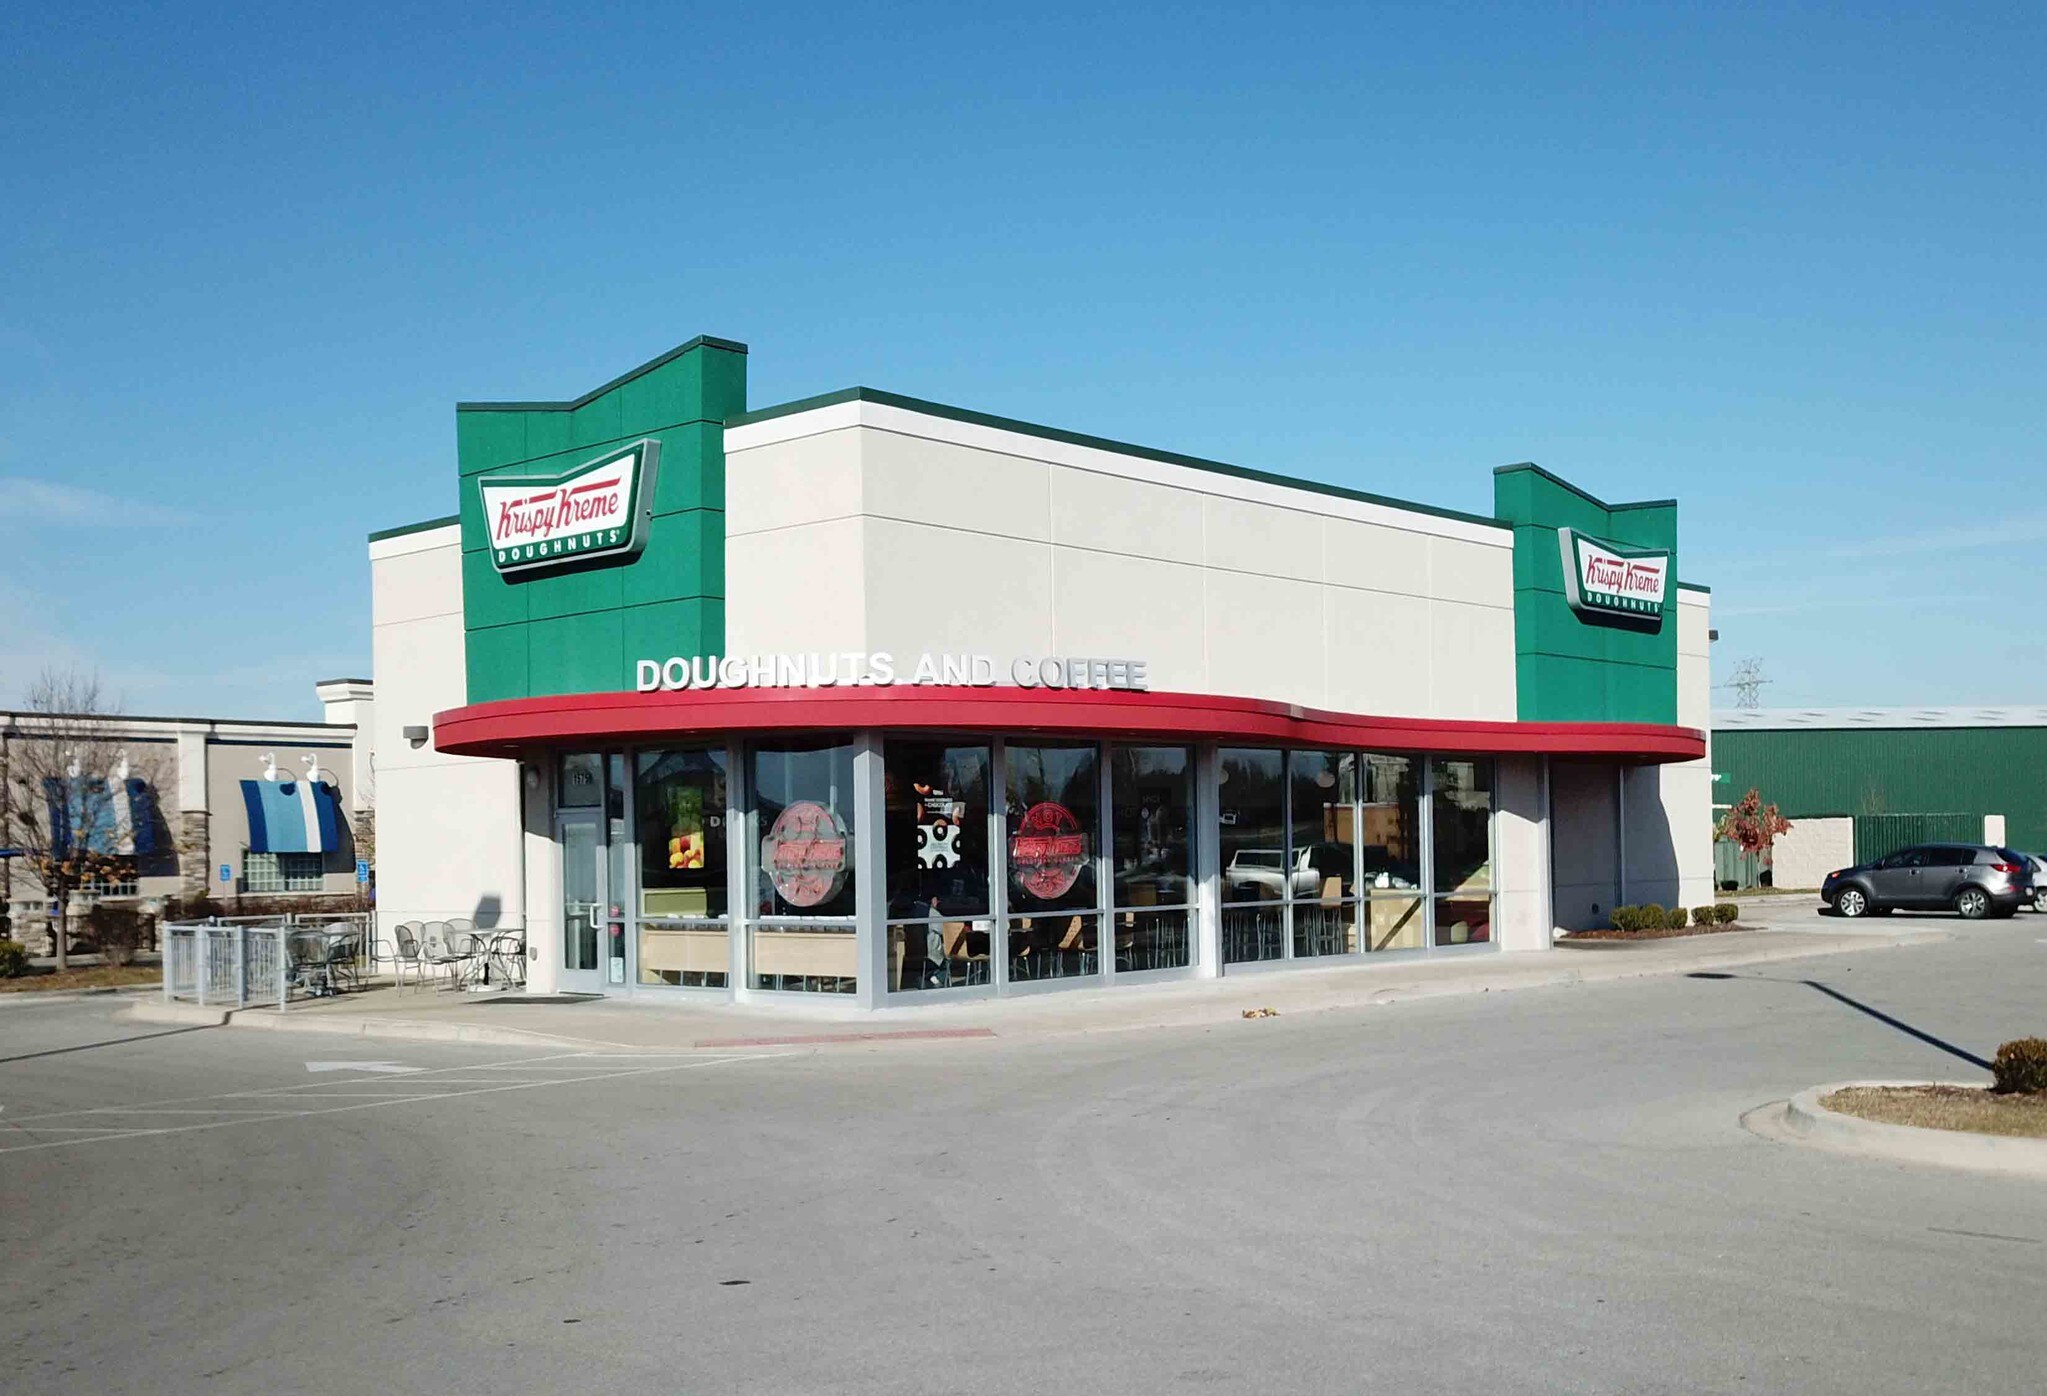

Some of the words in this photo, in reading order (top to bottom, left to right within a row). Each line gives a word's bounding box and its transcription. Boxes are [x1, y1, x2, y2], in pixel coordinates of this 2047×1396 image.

[496, 489, 557, 540] Krispy
[556, 476, 621, 529] Kreme
[498, 529, 618, 563] DOUGHNUTS
[1585, 554, 1624, 594] Krispy
[1624, 562, 1660, 593] Kreme
[1587, 592, 1659, 613] DOUGHNUTS
[637, 652, 895, 693] DOUGHNUTS
[914, 653, 997, 688] AND
[1011, 656, 1148, 692] COFFEE
